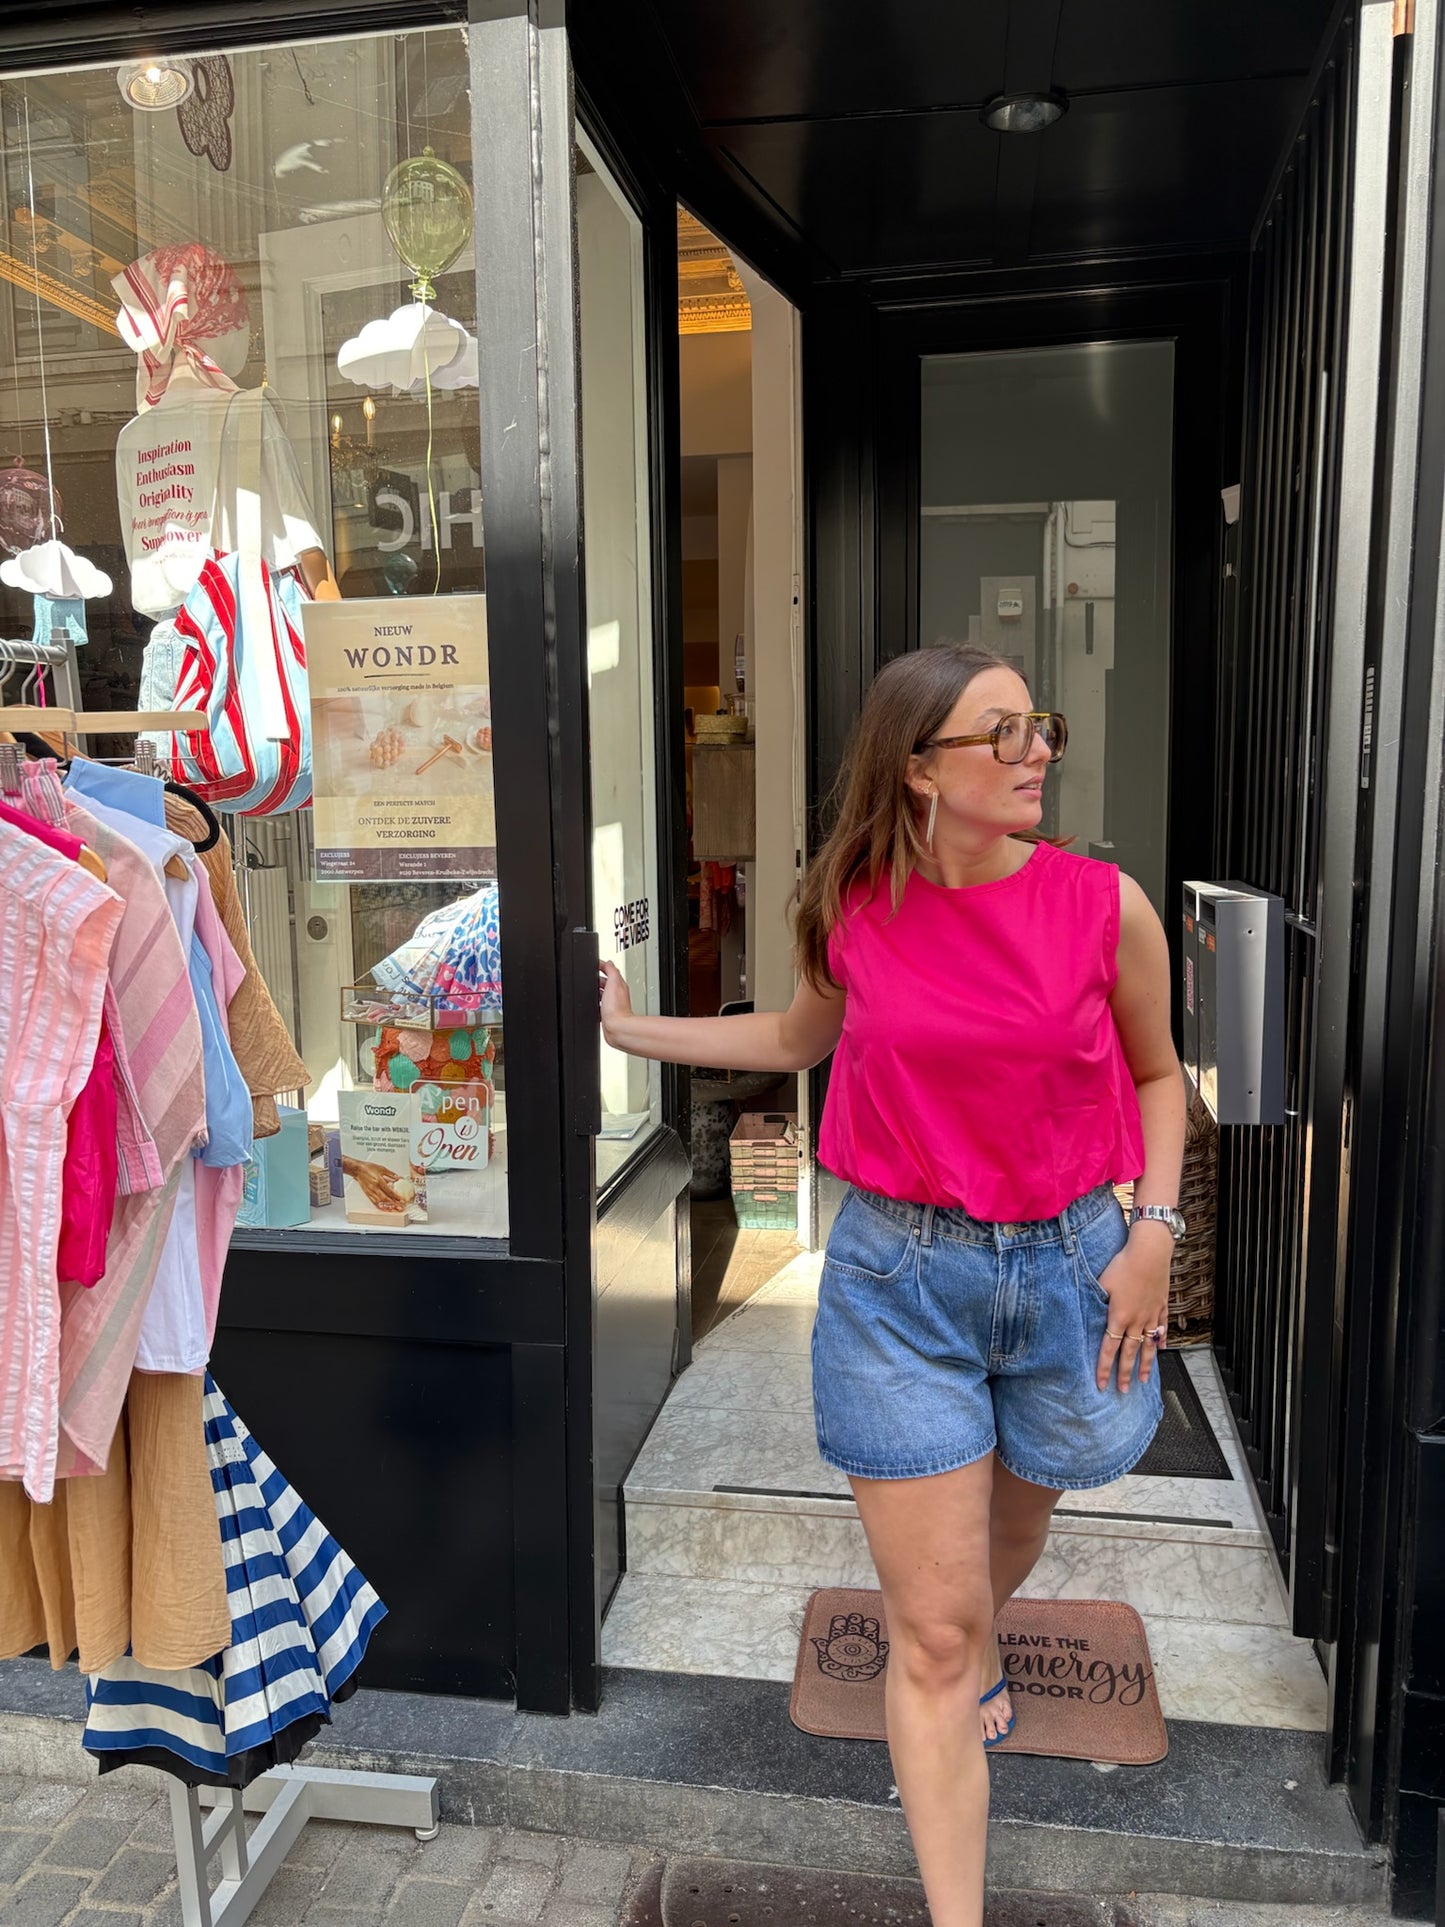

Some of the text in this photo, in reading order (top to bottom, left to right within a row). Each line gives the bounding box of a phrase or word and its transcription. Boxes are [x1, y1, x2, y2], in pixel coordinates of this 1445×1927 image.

[137, 440, 192, 464] Inspiration
[136, 463, 195, 487] Enthusiasm
[139, 484, 194, 508] Origiality
[374, 625, 413, 637] NIEUW
[344, 644, 460, 668] WONDR
[432, 682, 454, 690] Belgium
[358, 816, 452, 825] ONTDEK DE ZUIVERE
[376, 830, 436, 839] VERZORGING
[614, 898, 649, 930] COME FOR
[615, 919, 650, 953] THE VIBES
[365, 1105, 396, 1117] Wondr
[460, 1119, 472, 1137] is
[417, 1127, 480, 1168] Open
[998, 1632, 1090, 1651] LEAVE THE
[1003, 1651, 1154, 1706] energy
[1007, 1682, 1084, 1701] DOOR
